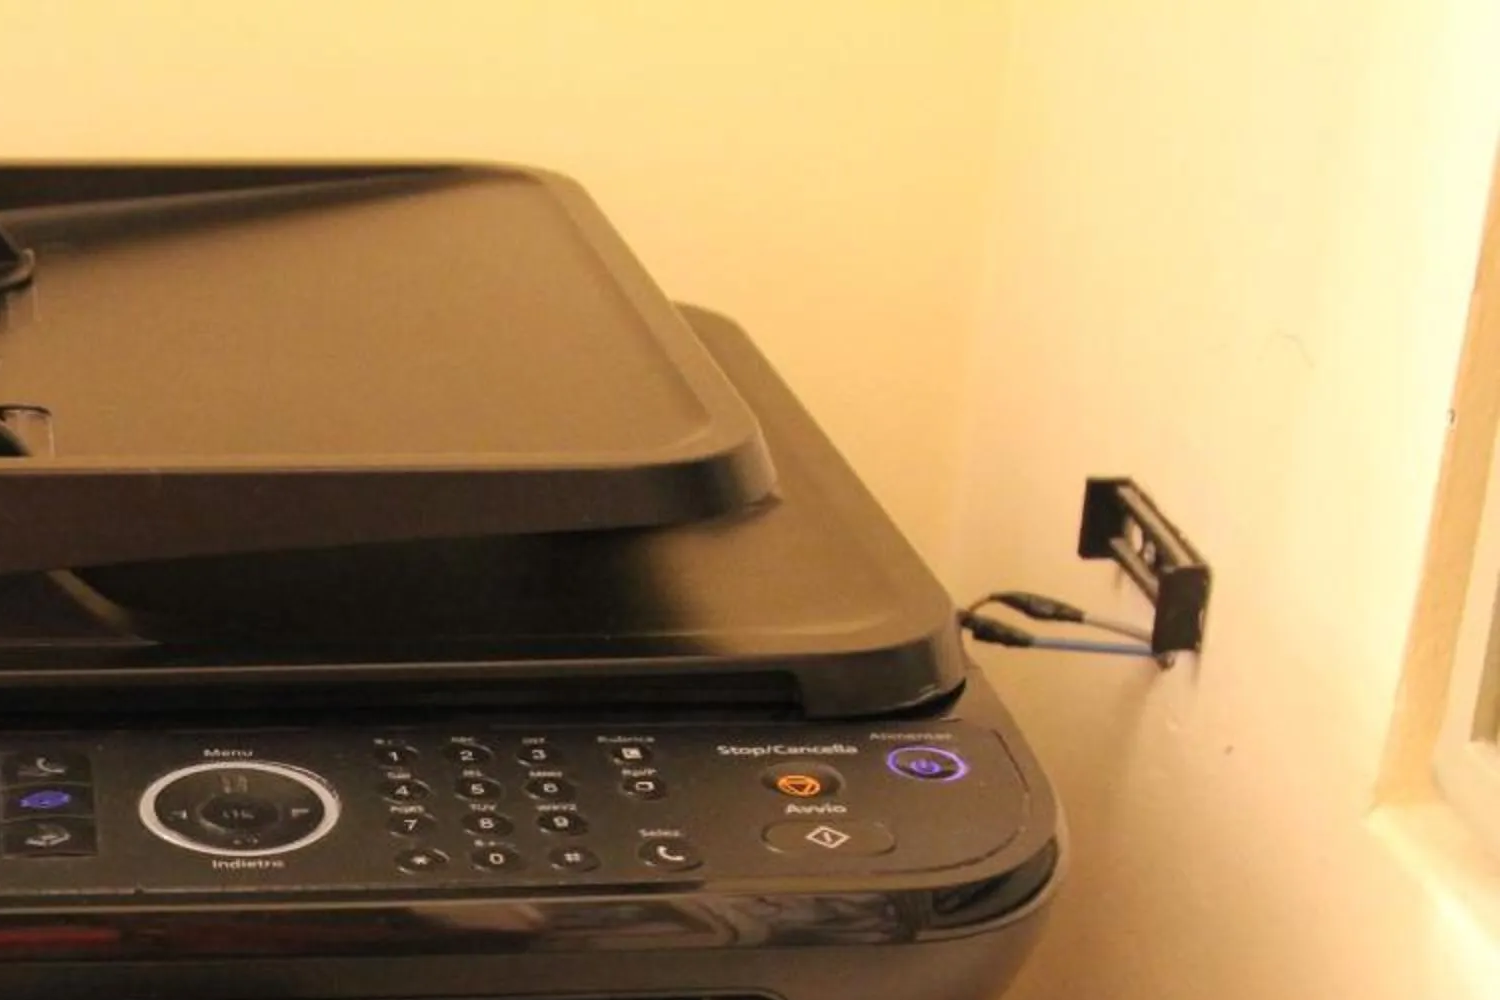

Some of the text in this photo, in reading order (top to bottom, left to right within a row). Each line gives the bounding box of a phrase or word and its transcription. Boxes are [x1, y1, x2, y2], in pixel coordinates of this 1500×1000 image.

[203, 748, 254, 758] Menu
[388, 749, 547, 762] 1 2 3
[716, 743, 859, 757] Stop/Cancella
[395, 783, 559, 797] 4 5 6
[785, 803, 848, 815] Avvio
[403, 816, 569, 831] 7 8 9
